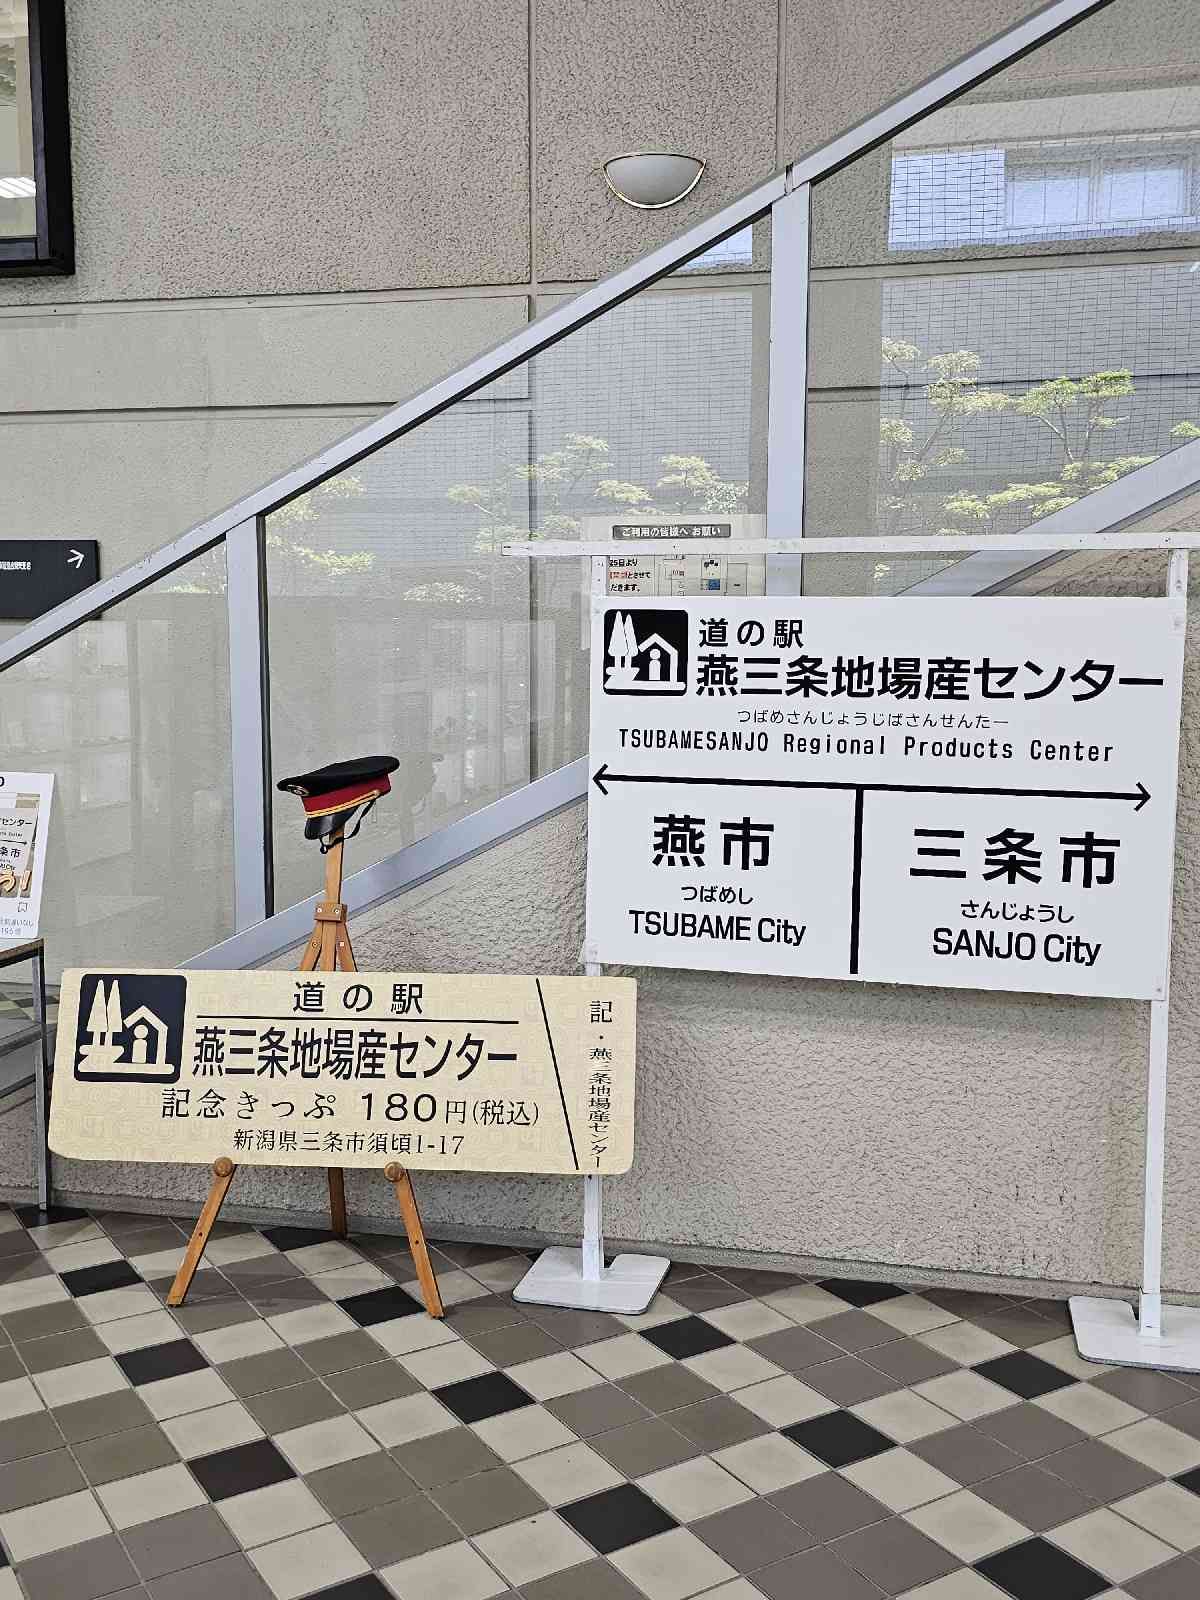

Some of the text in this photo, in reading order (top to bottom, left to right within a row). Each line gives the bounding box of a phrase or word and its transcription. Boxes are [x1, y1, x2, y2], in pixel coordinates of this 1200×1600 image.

[699, 618, 803, 648] 道の駅
[696, 654, 1163, 701] 燕三条地場産センター
[738, 710, 1008, 728] つばめさんじょうじばさんせんたー
[619, 729, 1113, 761] TSUBAMESANJO Regional Products Center
[0, 818, 33, 826] センター
[652, 814, 774, 870] 燕市
[910, 828, 1120, 888] 三条市
[681, 886, 753, 904] つばめし
[961, 900, 1074, 923] さんじょうし
[629, 910, 806, 946] TSUBAME City
[933, 928, 1101, 966] SANJO City
[293, 982, 422, 1014] 道の駅
[192, 1026, 517, 1080] 燕三条地場産センター
[162, 1088, 336, 1119] 記念きっぷ
